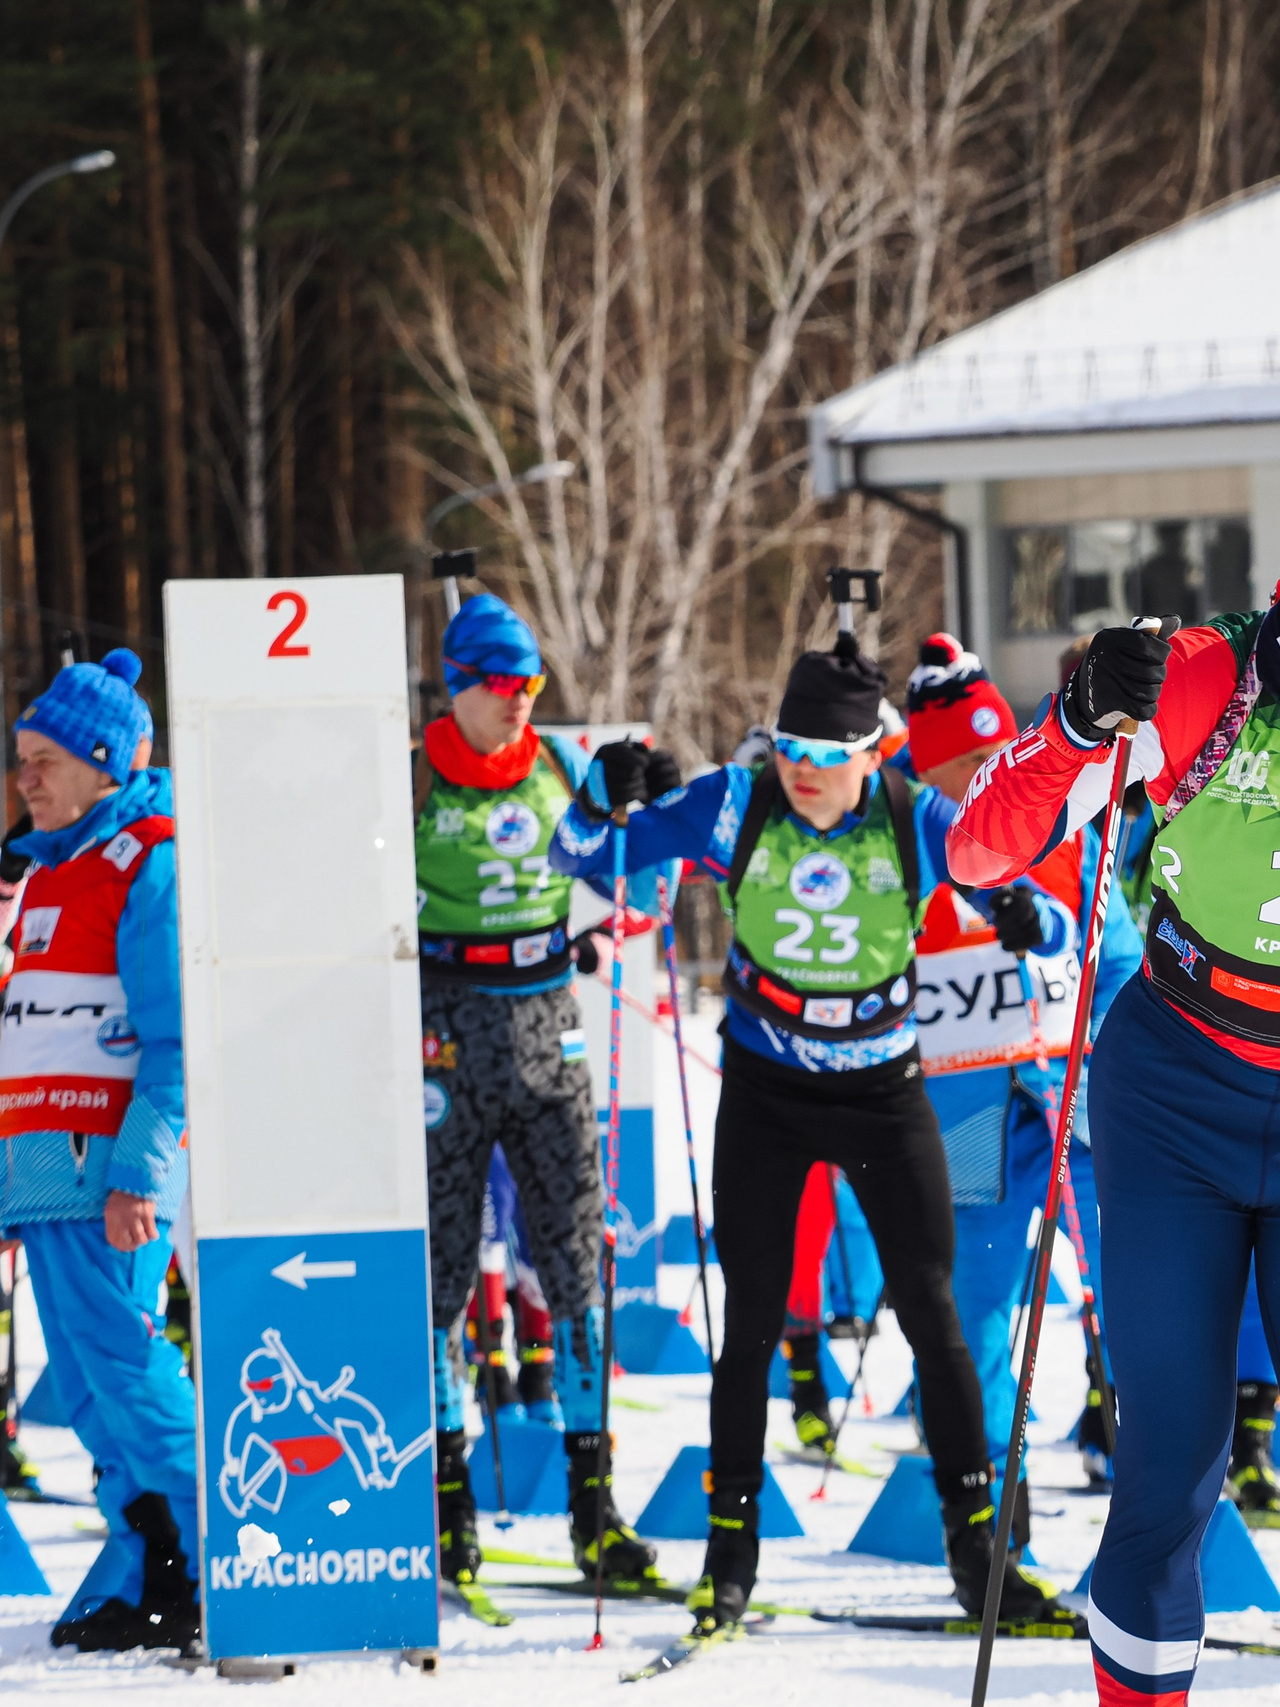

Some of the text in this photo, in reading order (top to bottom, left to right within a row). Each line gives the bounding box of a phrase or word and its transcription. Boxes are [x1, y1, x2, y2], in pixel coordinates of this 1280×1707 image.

[266, 590, 310, 657] 2
[1211, 787, 1279, 801] МИНИСТЕРСТВО СПОРТА
[478, 855, 552, 907] 27
[1087, 800, 1122, 976] SWIX
[773, 908, 861, 964] 23
[48, 1087, 109, 1111] край
[1066, 1089, 1078, 1127] TRIAC
[1057, 1147, 1069, 1184] AERO
[210, 1545, 433, 1591] КРАСНОЯРСК
